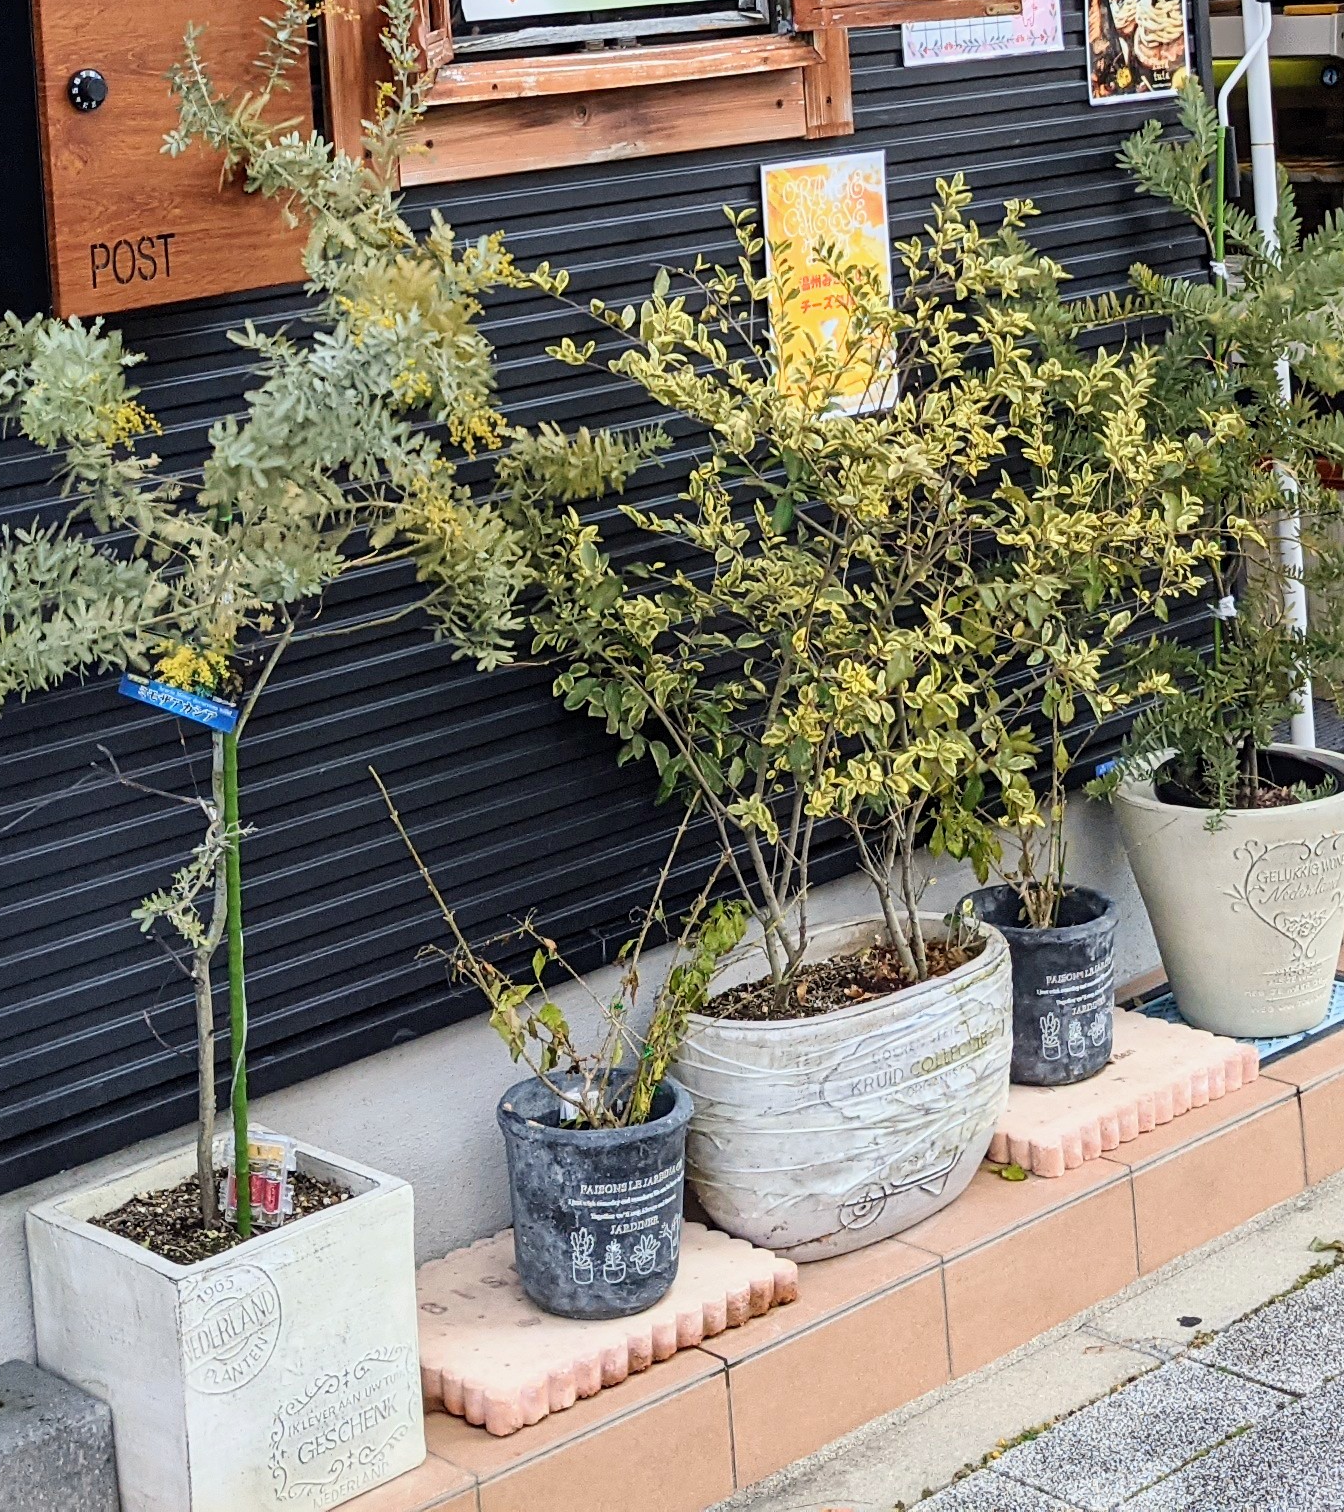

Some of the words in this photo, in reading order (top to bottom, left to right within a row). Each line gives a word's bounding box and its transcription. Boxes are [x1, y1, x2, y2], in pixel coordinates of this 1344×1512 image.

[783, 199, 867, 238] CHEESE
[90, 233, 176, 289] POST
[1257, 863, 1319, 883] GELUKKIG
[183, 1290, 275, 1363] NEDERLAND
[298, 1393, 400, 1465] GESCHENK
